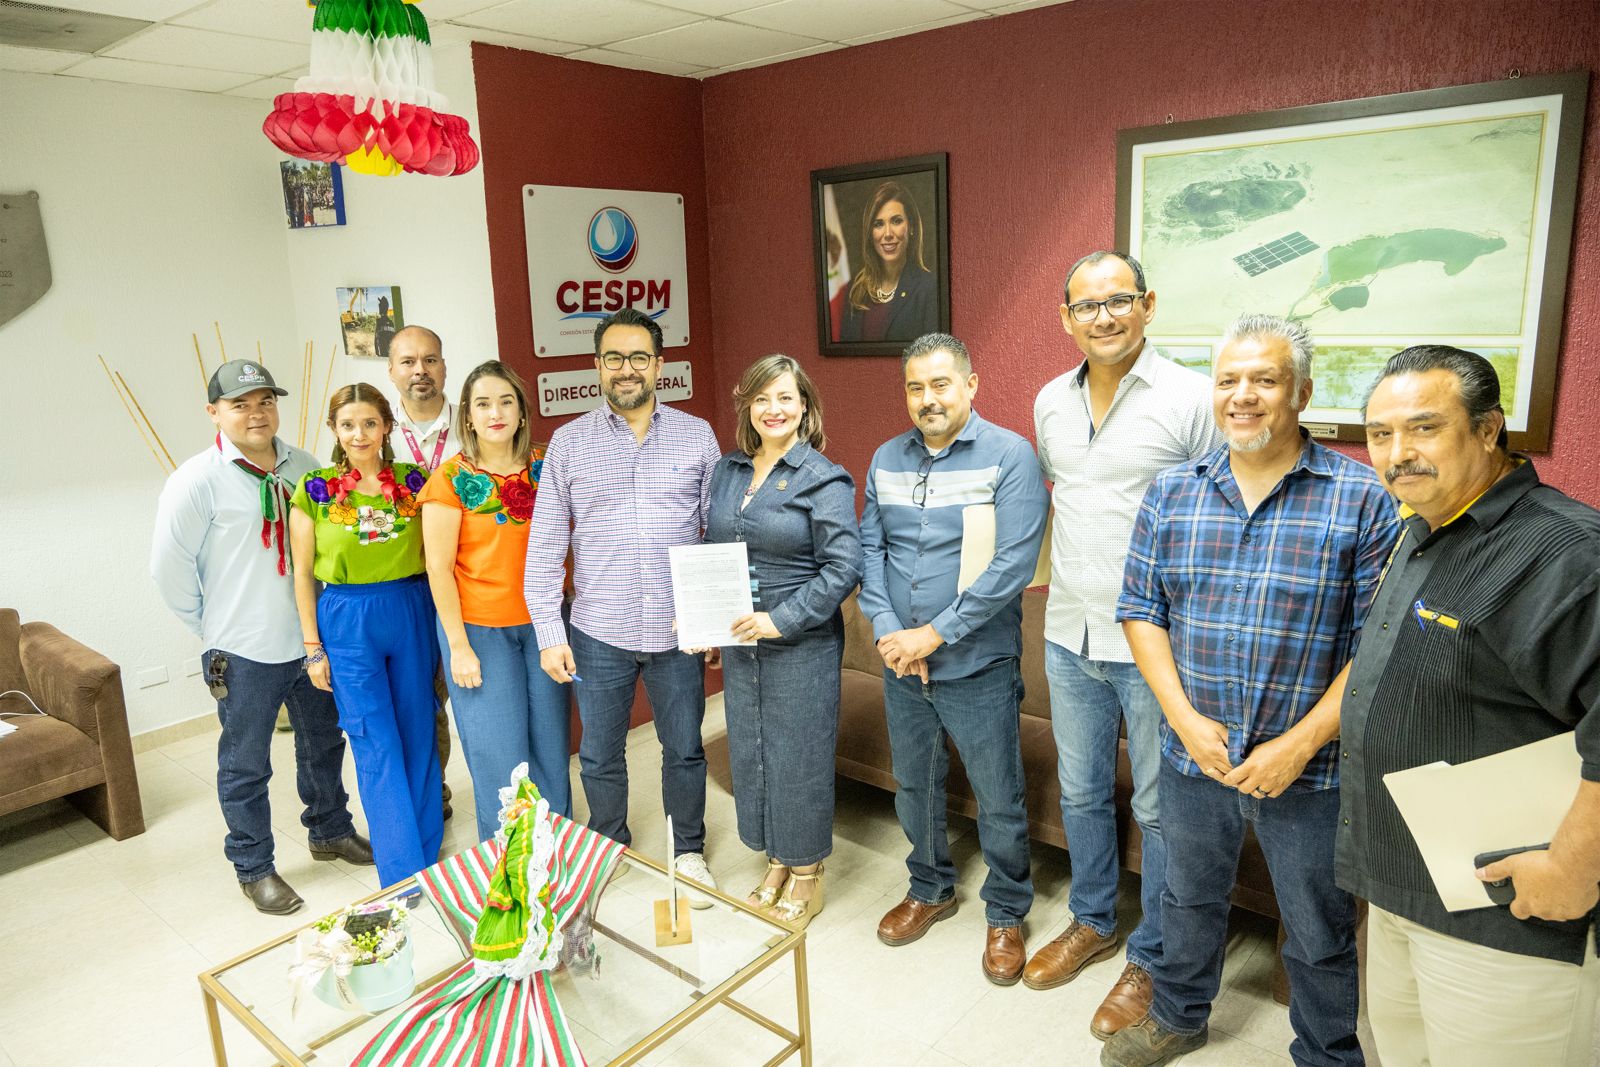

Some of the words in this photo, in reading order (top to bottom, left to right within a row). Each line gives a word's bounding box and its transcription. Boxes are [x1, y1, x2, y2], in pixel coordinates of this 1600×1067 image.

[556, 280, 671, 313] CESPM
[544, 384, 602, 402] DIRECCI
[656, 376, 688, 391] ERAL
